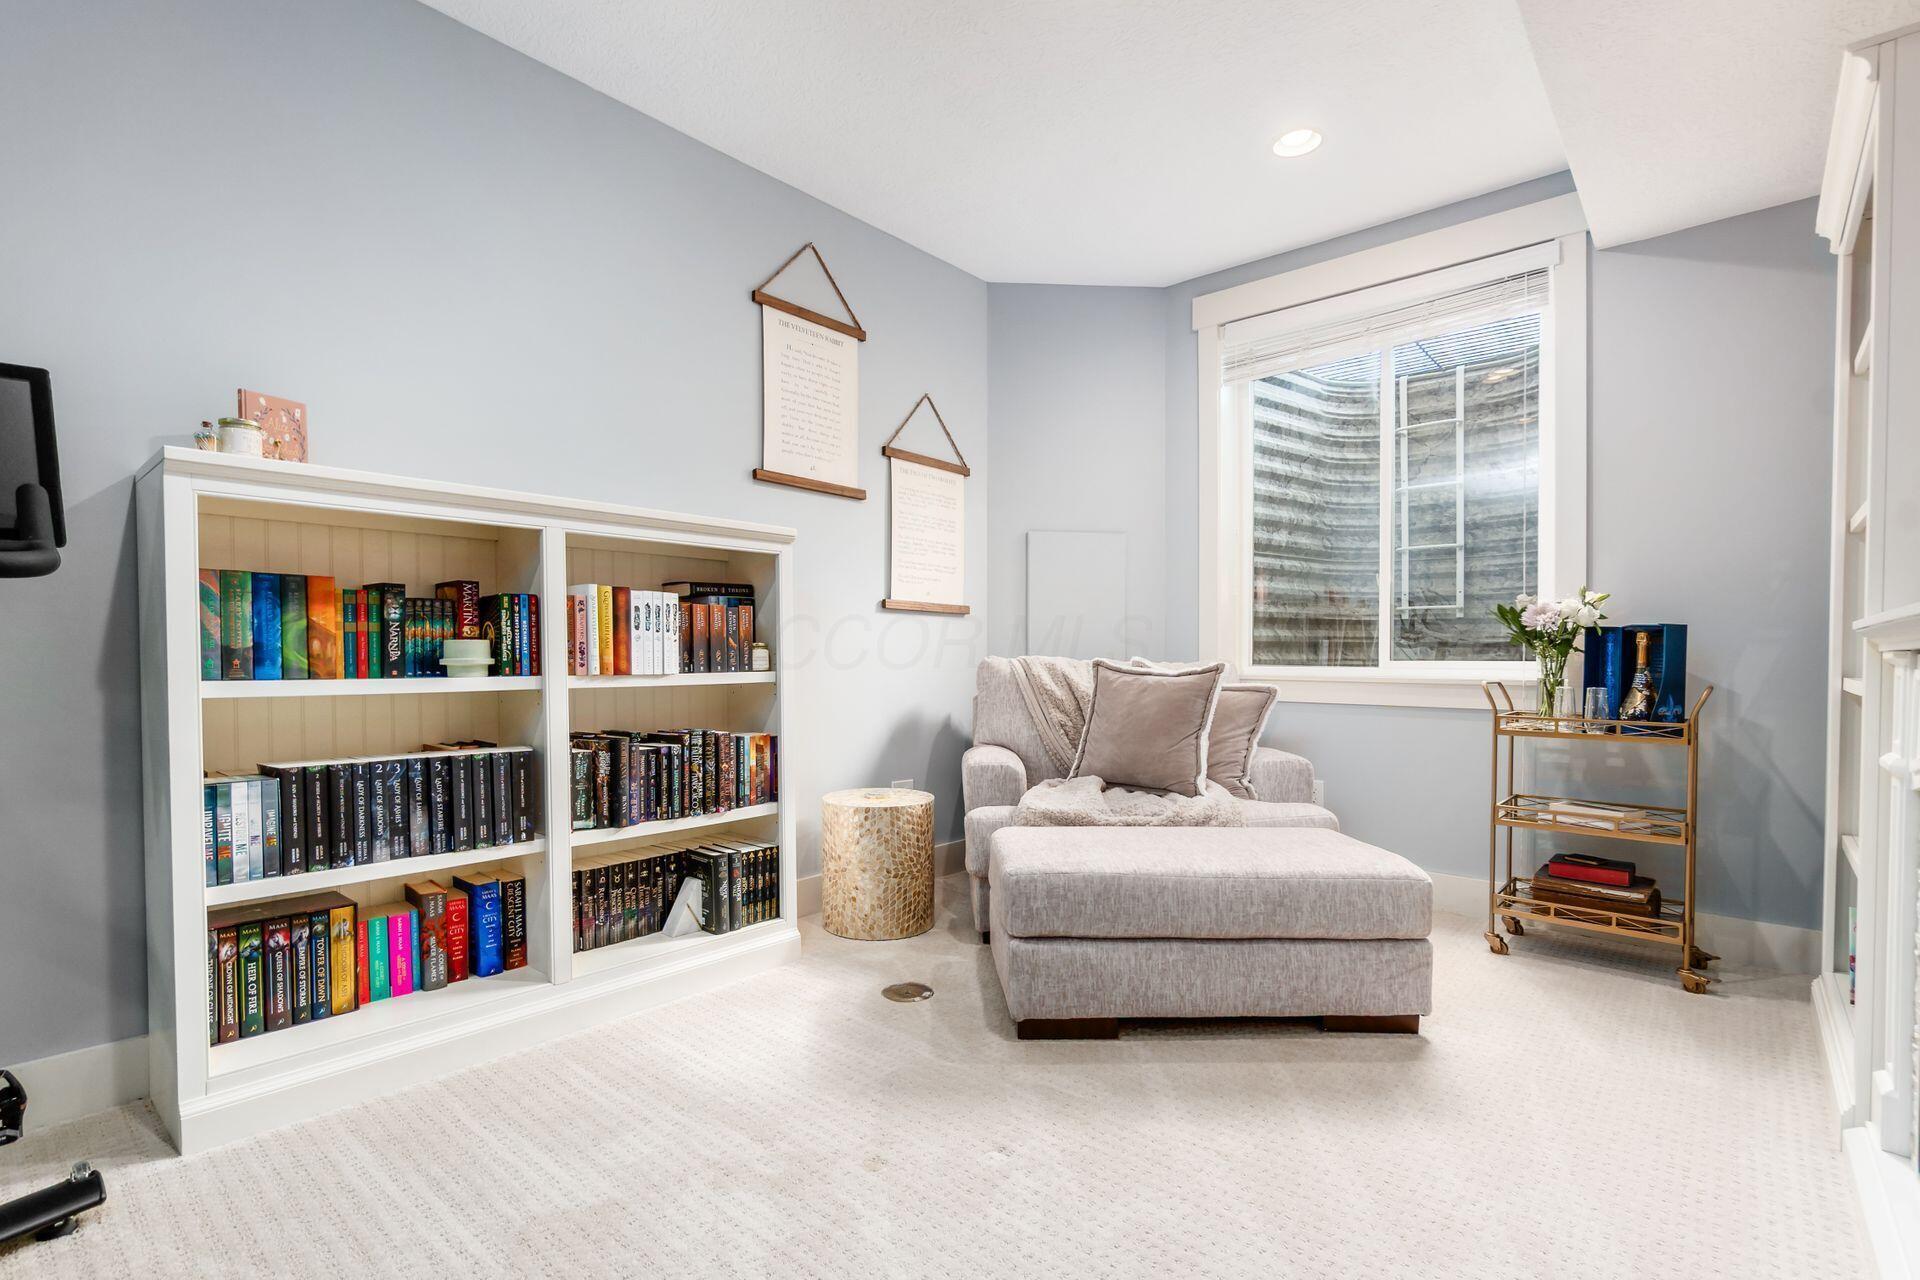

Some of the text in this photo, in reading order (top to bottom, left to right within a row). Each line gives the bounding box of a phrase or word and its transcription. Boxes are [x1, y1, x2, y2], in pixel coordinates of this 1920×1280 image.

[779, 319, 790, 329] THE
[462, 583, 472, 624] MARTIN
[388, 621, 401, 661] NARNIA
[375, 779, 383, 794] LADY
[219, 814, 231, 841] IGNITE
[266, 809, 276, 836] IMAGINE
[376, 804, 384, 836] SHADOWS
[506, 882, 514, 920] CRESCENT
[220, 931, 237, 939] MAAS
[242, 927, 259, 935] MAAS
[268, 922, 288, 930] MAAS
[275, 951, 283, 972] QUEEN
[298, 946, 306, 970] EMPIRE
[316, 938, 325, 965] TOWER
[248, 962, 256, 982] HEIR
[318, 979, 326, 1002] DAWN
[248, 997, 257, 1015] FIRE
